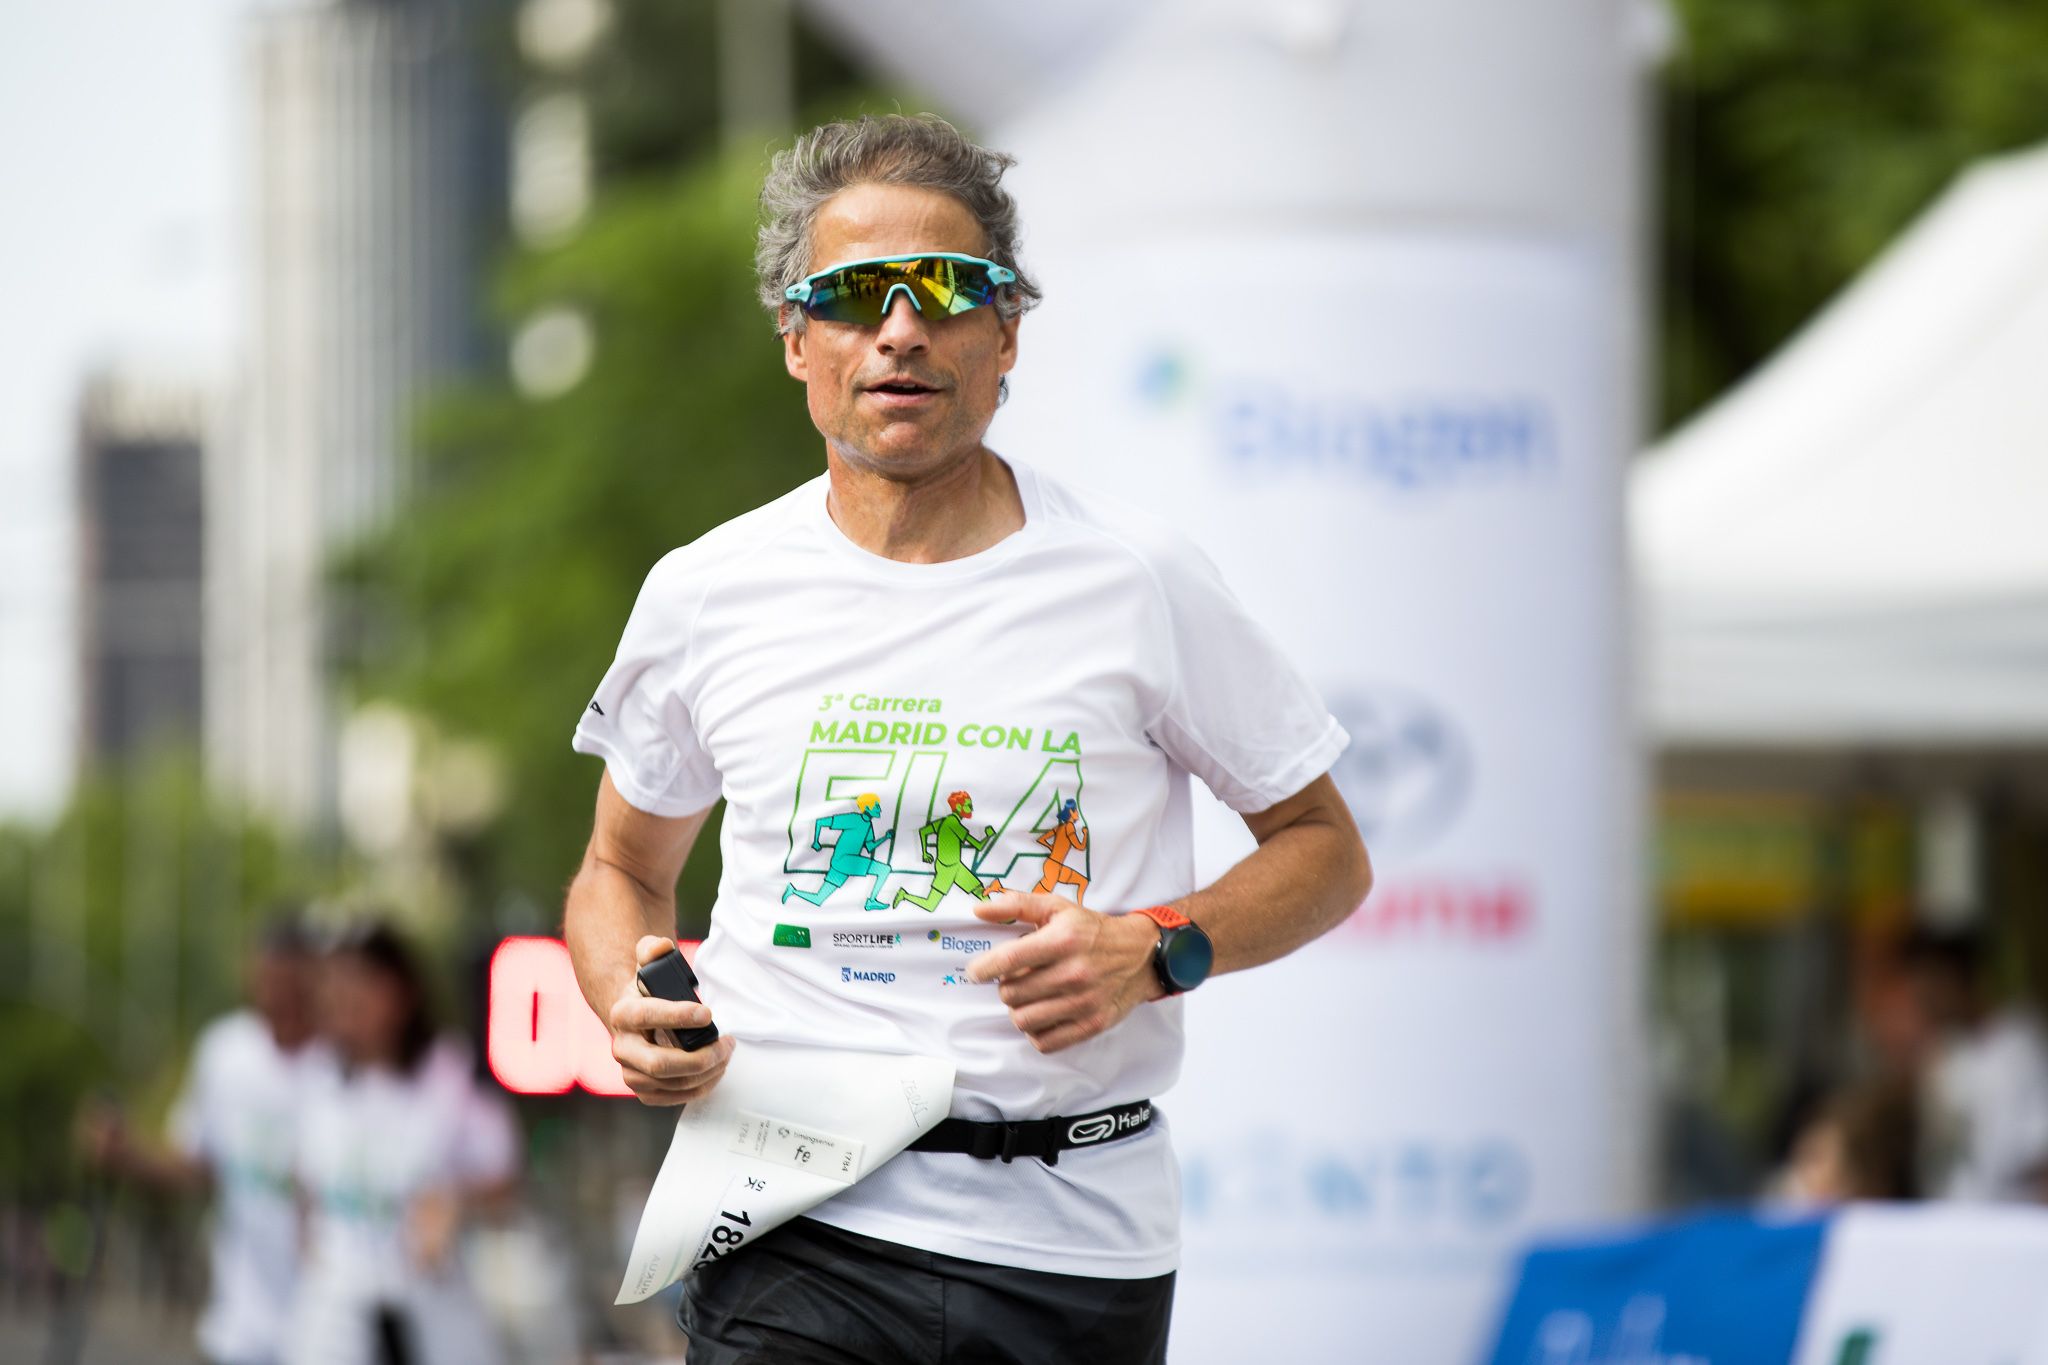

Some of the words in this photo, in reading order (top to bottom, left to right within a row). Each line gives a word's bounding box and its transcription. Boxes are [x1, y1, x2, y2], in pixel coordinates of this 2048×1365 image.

[849, 693, 942, 713] Carrera
[809, 720, 948, 746] MADRID
[957, 723, 1033, 751] CON
[1041, 729, 1081, 755] LA
[783, 749, 1091, 883] ELA
[942, 936, 991, 953] Biogen
[853, 971, 896, 984] MADRID
[1119, 1104, 1152, 1131] Kale
[744, 1176, 766, 1192] 5K
